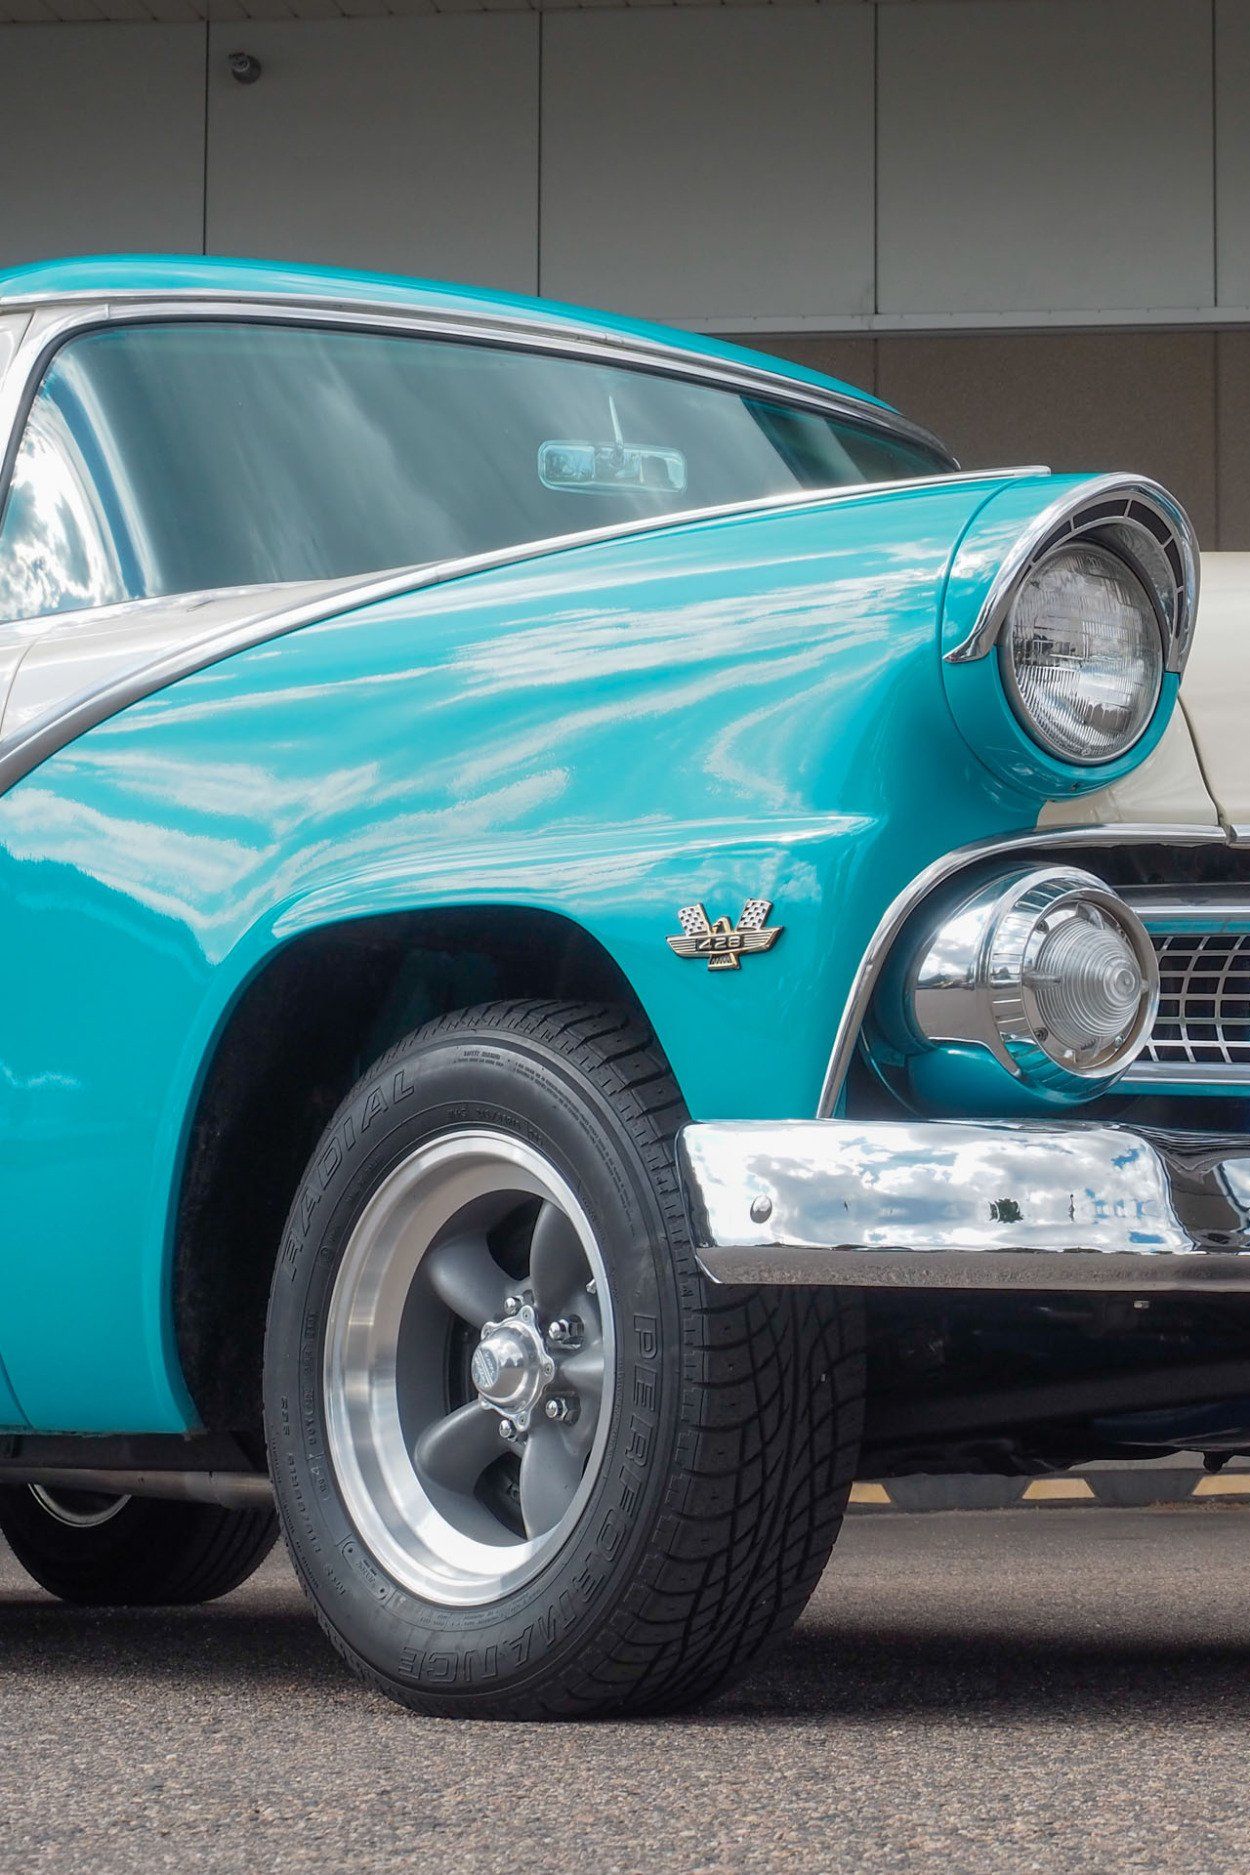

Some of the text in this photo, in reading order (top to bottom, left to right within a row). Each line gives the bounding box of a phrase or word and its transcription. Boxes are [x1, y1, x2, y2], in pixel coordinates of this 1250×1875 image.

[699, 935, 741, 950] 428
[281, 1069, 415, 1282] RADIAL
[399, 1313, 659, 1684] PERFORMANCE
